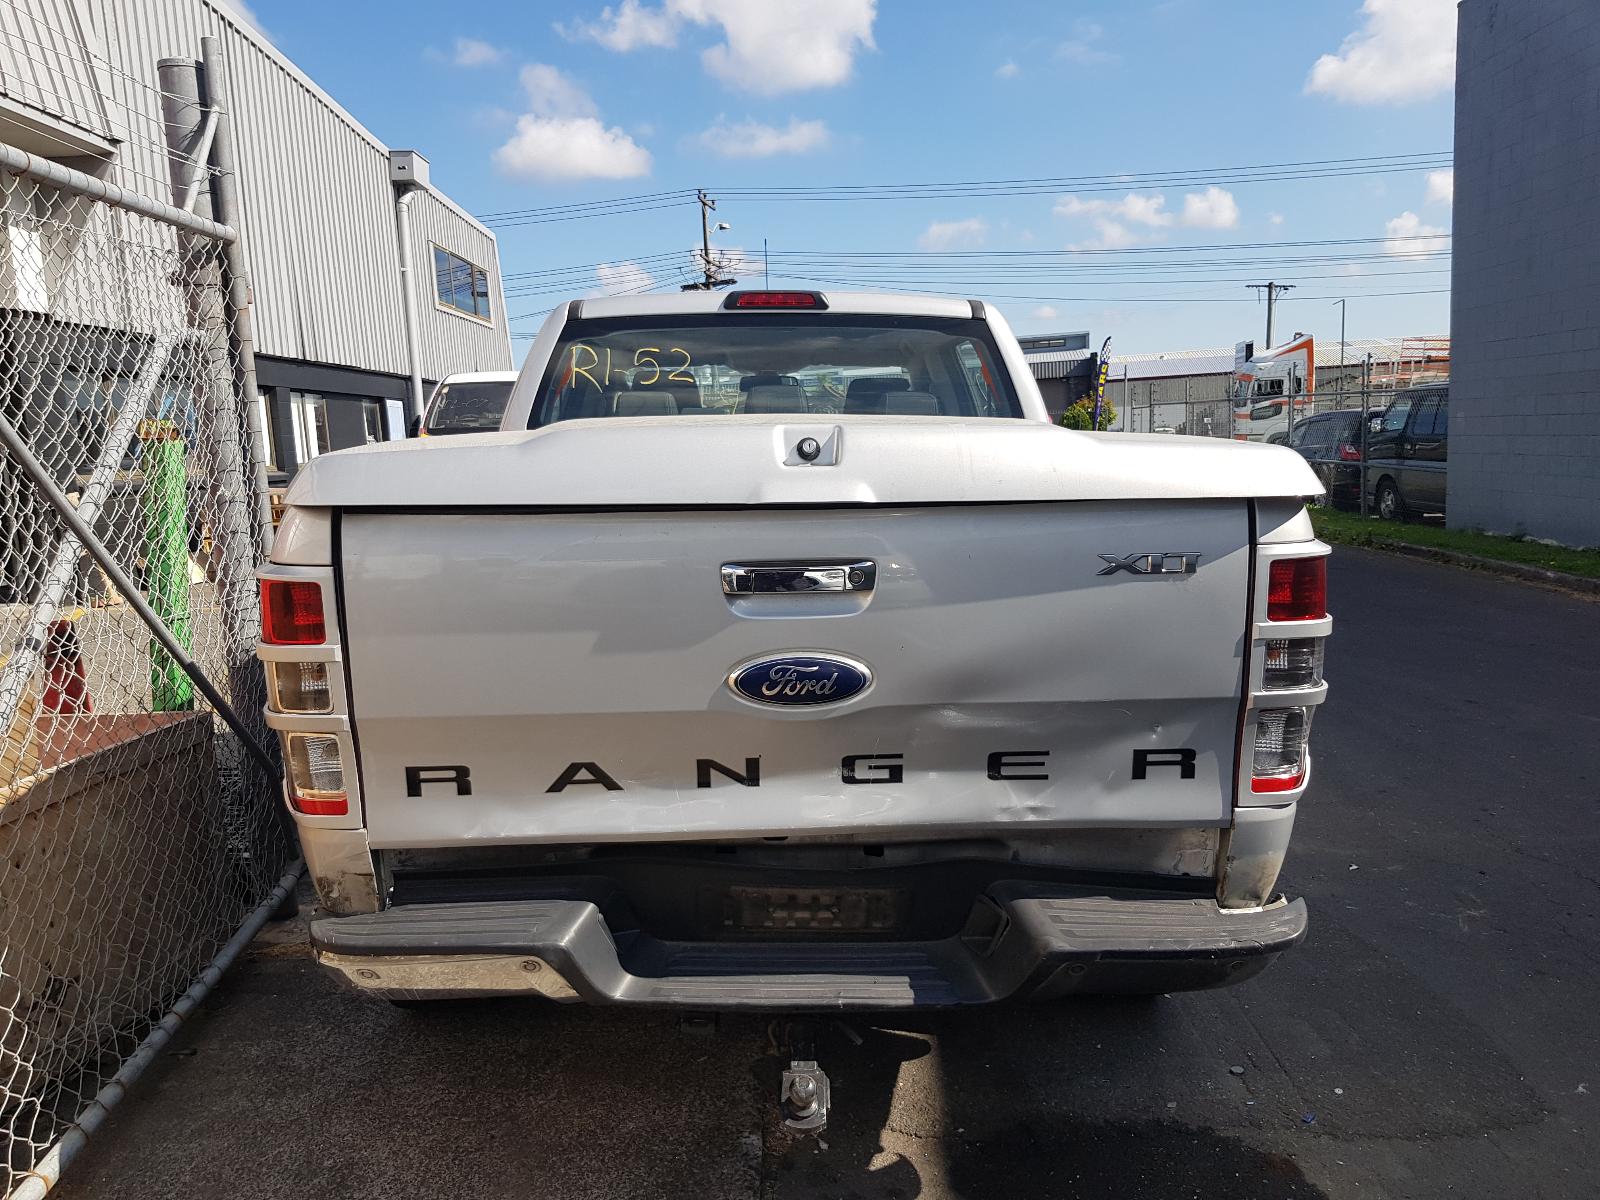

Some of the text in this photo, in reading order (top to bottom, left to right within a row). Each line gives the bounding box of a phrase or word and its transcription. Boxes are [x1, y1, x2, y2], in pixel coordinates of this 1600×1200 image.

[1096, 552, 1202, 575] XLT
[761, 665, 838, 696] Ford
[405, 748, 1197, 798] RANGER
